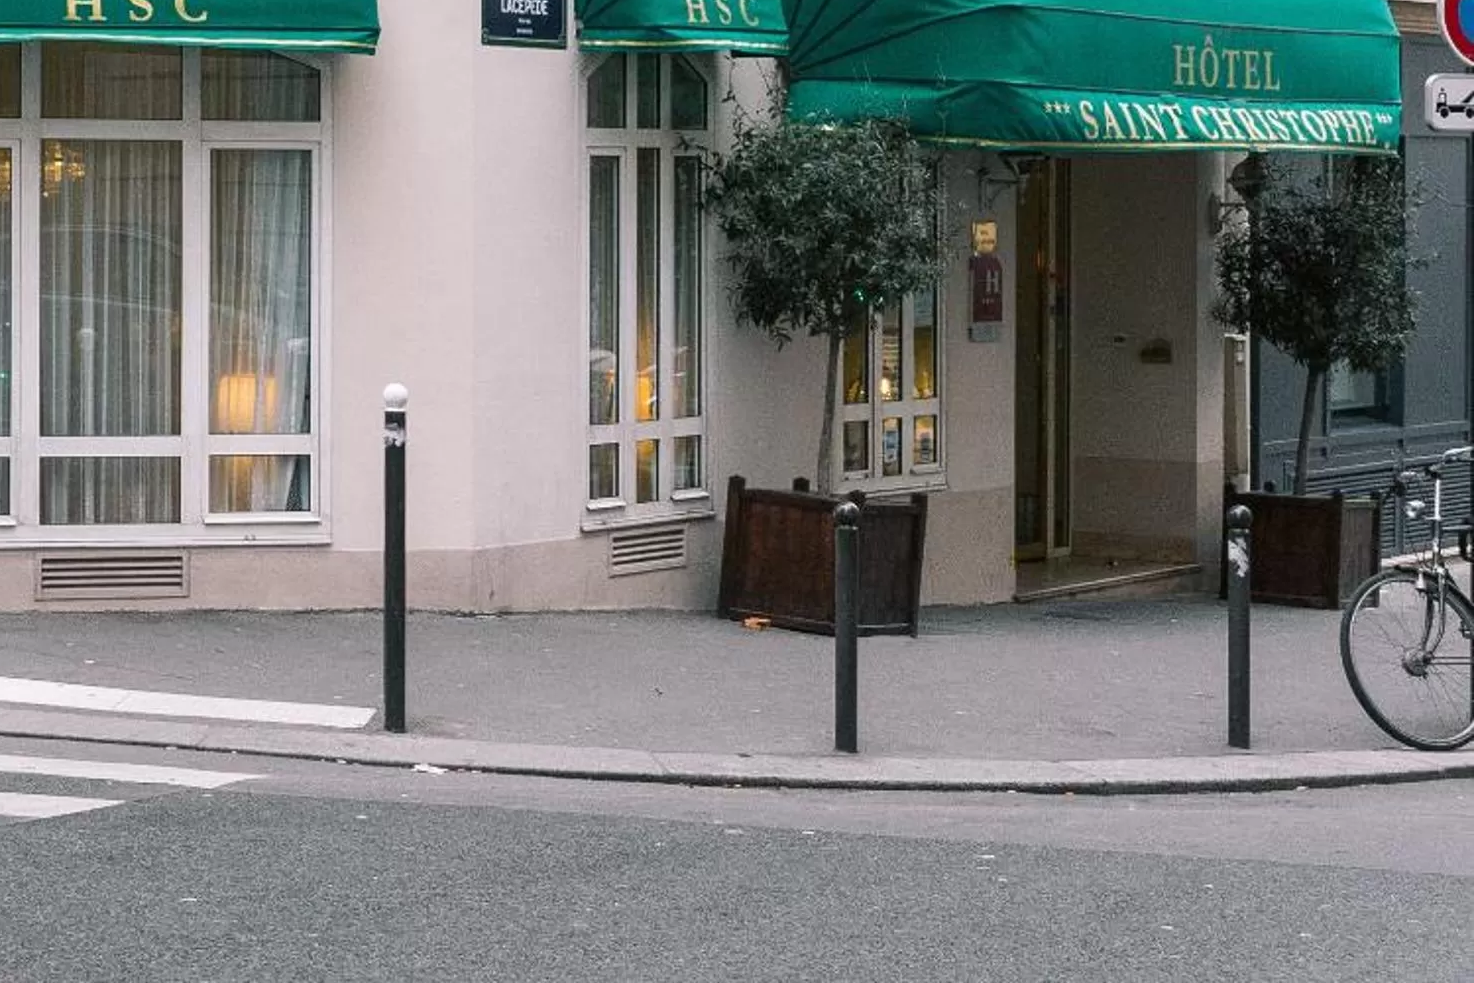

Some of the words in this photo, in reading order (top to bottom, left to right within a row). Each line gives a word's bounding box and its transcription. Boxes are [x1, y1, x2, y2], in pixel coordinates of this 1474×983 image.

[1173, 33, 1282, 91] HÔTEL
[1080, 100, 1190, 139] SAINT
[1190, 104, 1377, 144] CHRISTOPHE
